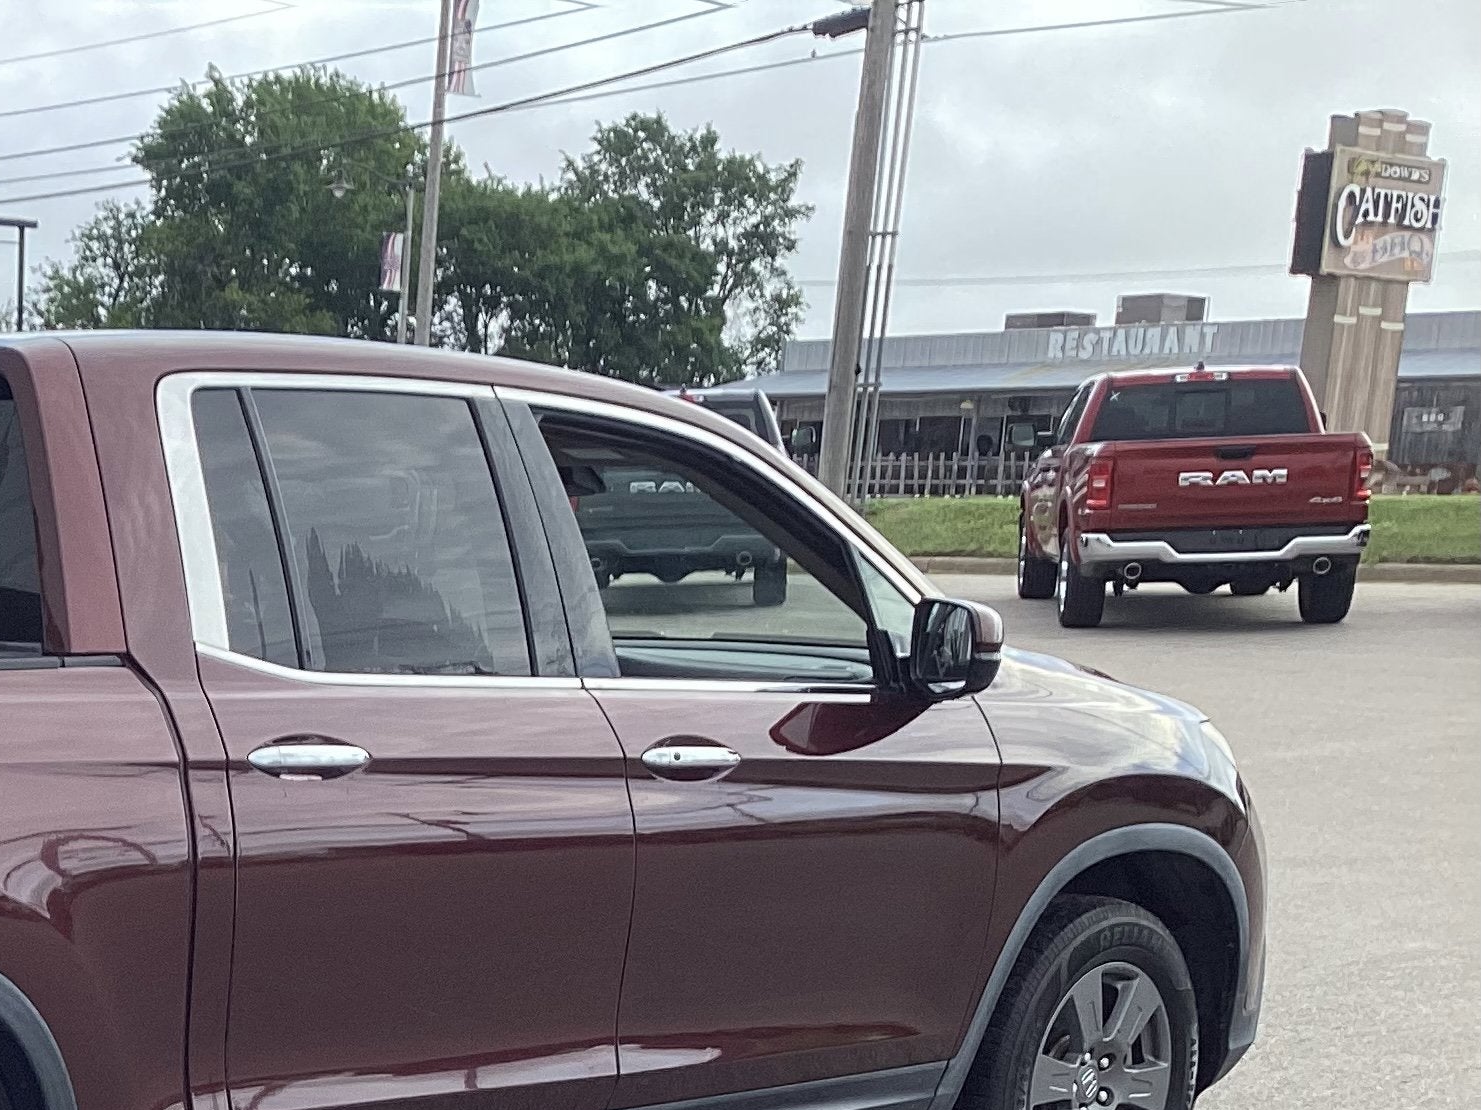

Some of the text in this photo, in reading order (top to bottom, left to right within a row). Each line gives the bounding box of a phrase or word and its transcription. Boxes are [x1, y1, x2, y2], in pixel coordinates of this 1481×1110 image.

[1335, 183, 1443, 248] CATFISH
[1047, 324, 1219, 361] RESTAURANT
[1178, 468, 1289, 487] RAM
